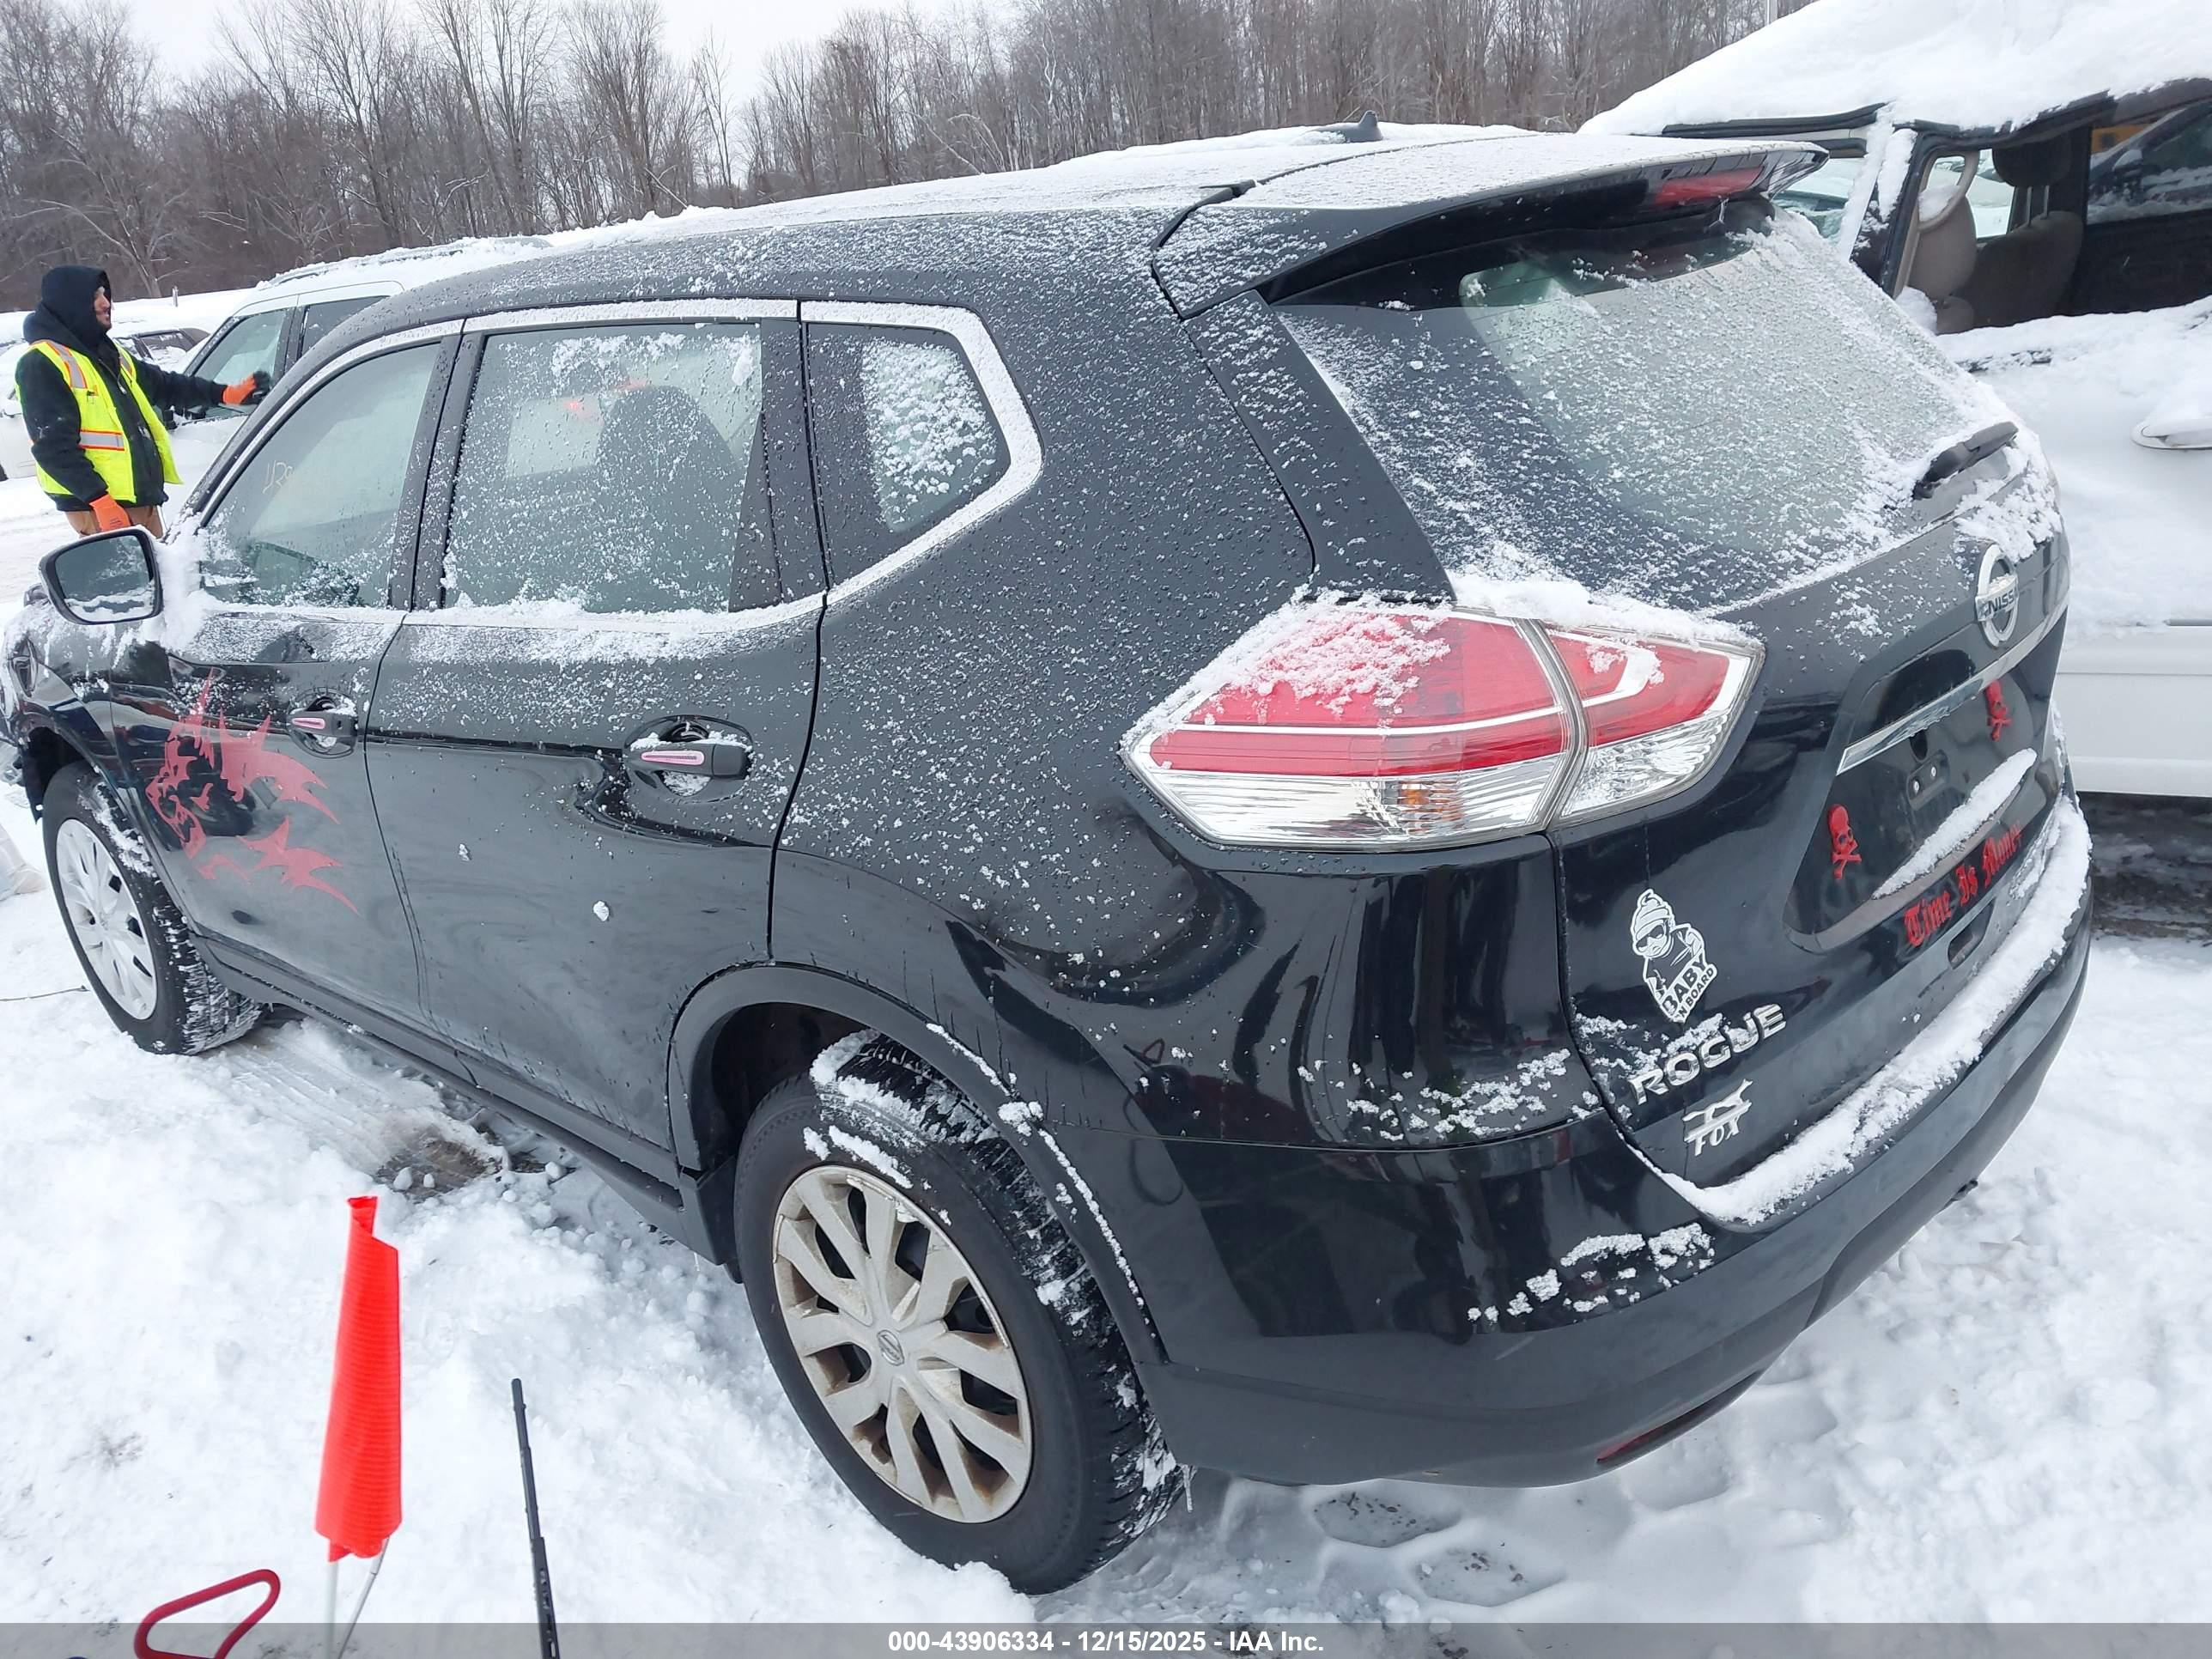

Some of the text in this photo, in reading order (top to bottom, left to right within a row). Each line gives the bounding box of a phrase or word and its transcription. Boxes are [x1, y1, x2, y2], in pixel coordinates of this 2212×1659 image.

[1905, 888, 1952, 948] Time
[1956, 864, 1978, 905] Is
[1662, 952, 1706, 1016] BABY
[1674, 968, 1714, 1019] N BOARD
[1627, 1003, 1787, 1105] ROGUE
[1693, 1115, 1741, 1157] FOX
